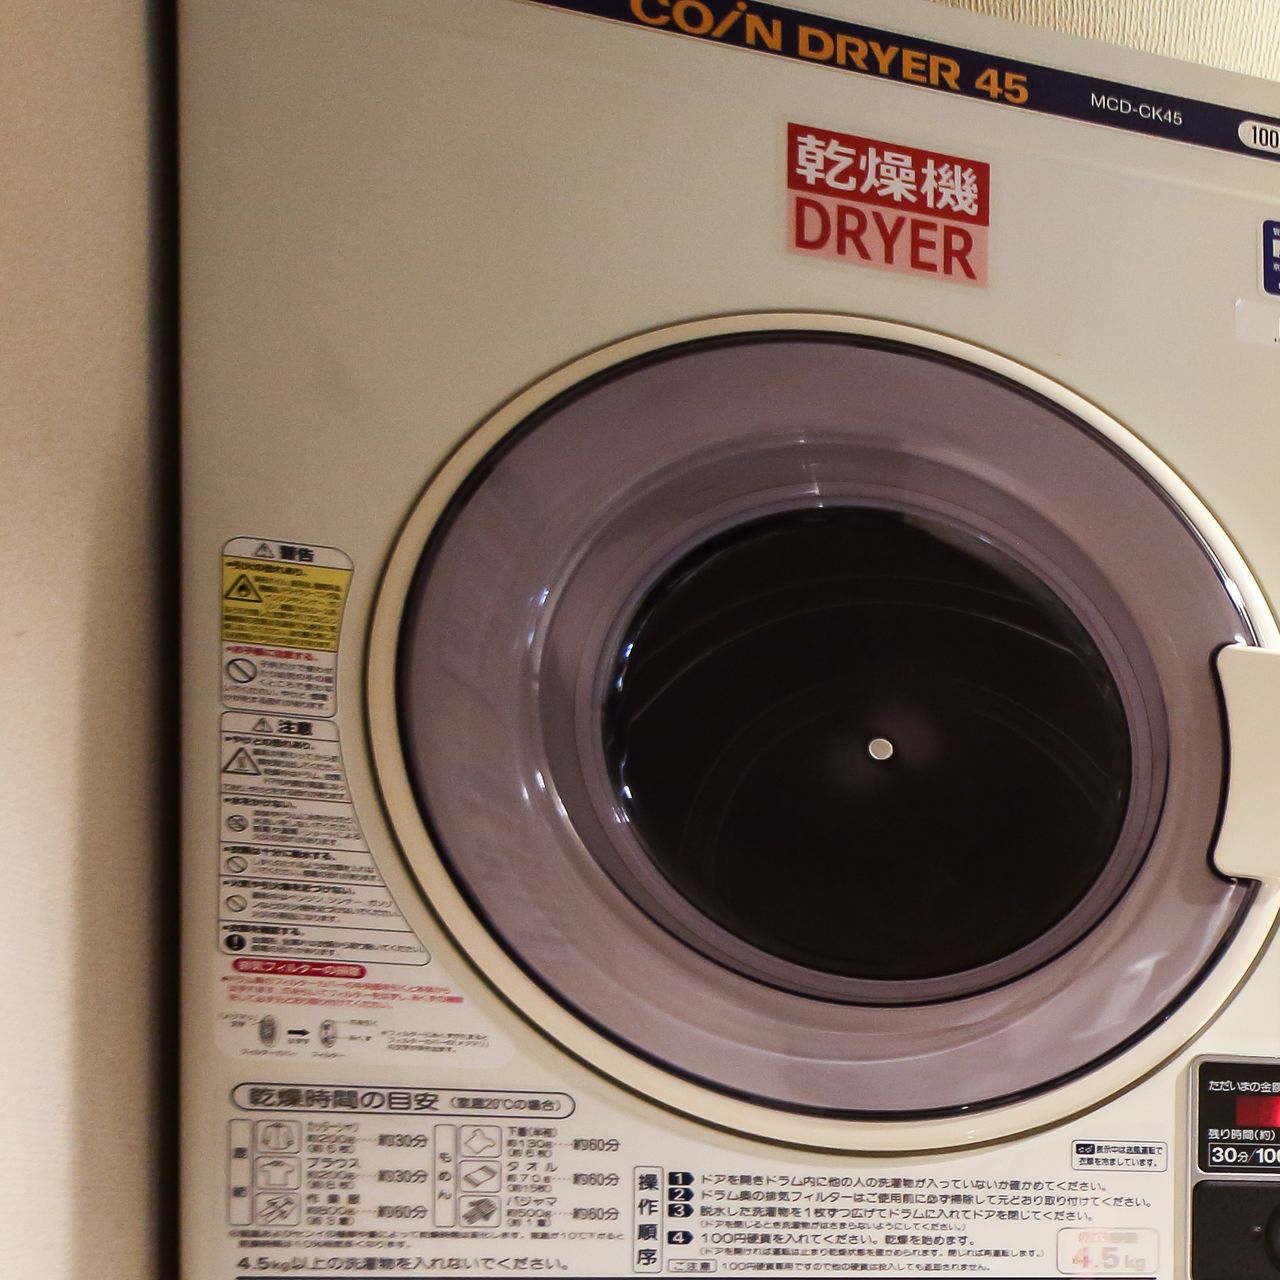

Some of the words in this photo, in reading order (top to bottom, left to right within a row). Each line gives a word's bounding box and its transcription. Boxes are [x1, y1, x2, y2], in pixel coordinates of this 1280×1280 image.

[799, 25, 961, 91] DRYER
[975, 69, 1029, 105] 45
[1090, 93, 1183, 126] MCD-CK45
[795, 135, 979, 217] 乾燥機
[794, 196, 977, 281] DRYER
[249, 1087, 440, 1111] 乾燥時間の目安
[637, 1173, 659, 1266] 操作順序
